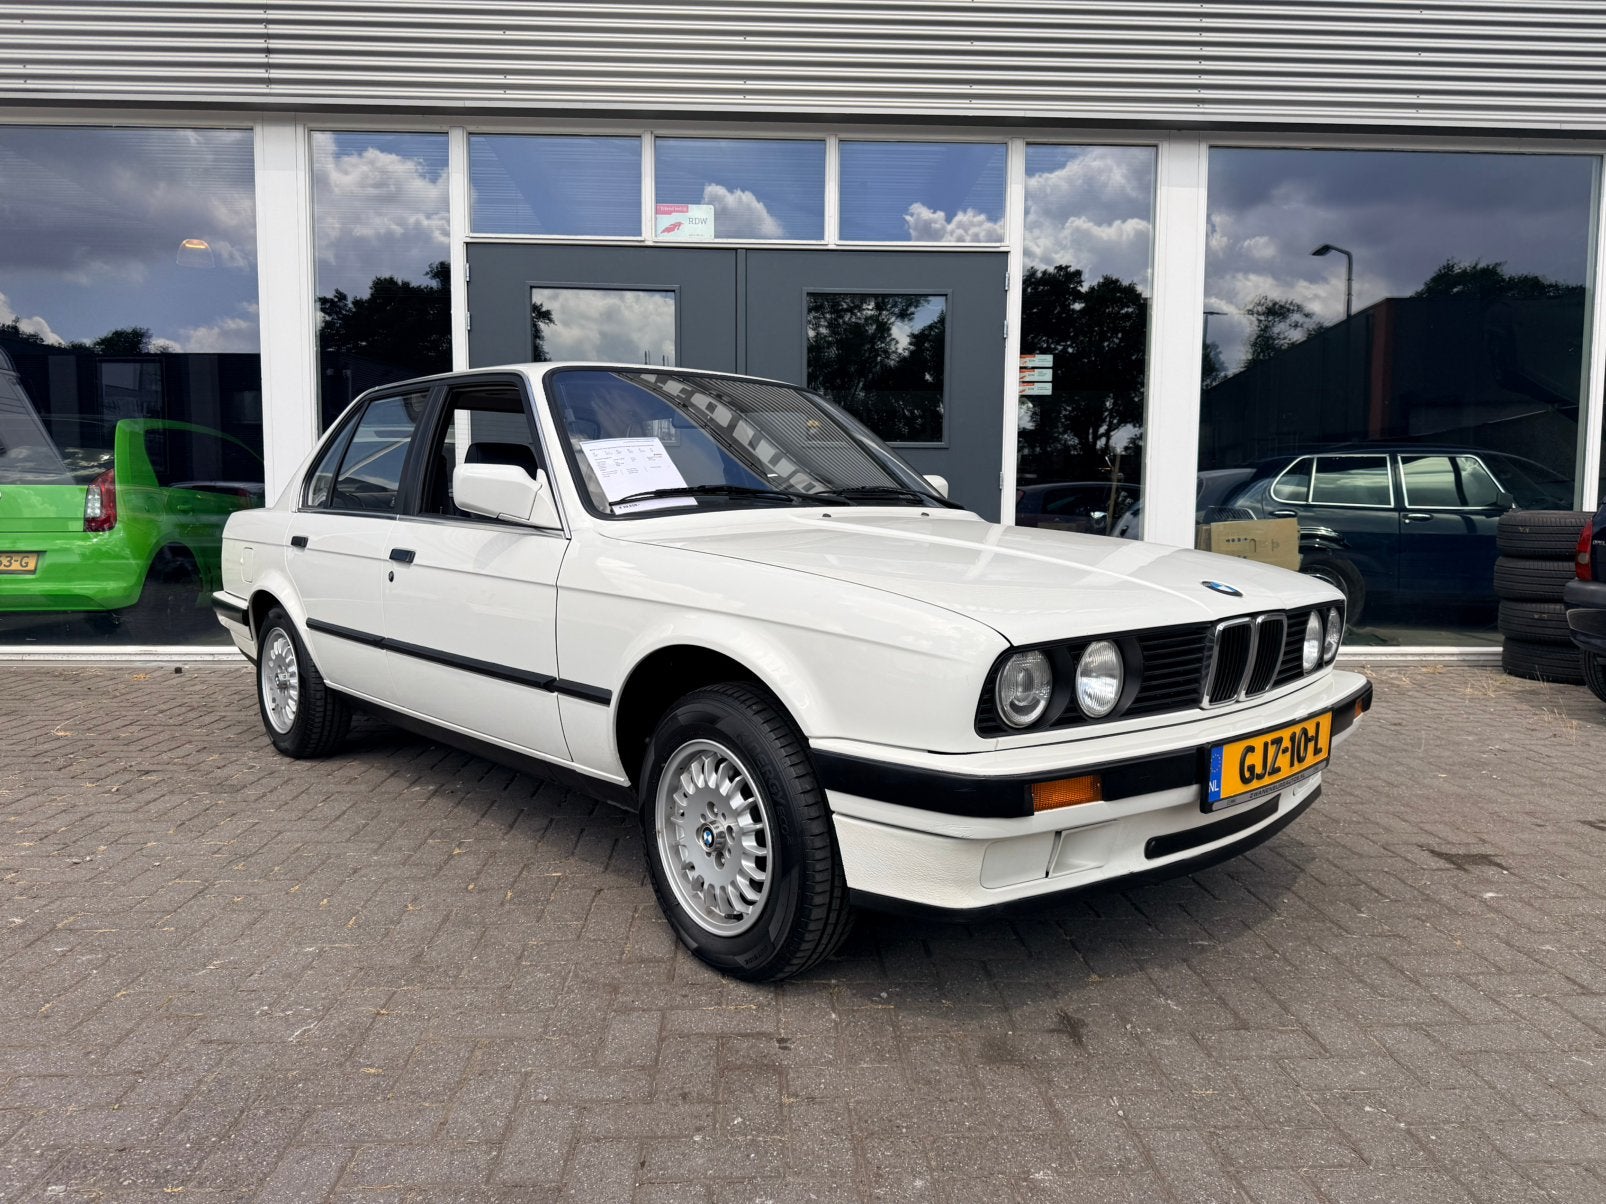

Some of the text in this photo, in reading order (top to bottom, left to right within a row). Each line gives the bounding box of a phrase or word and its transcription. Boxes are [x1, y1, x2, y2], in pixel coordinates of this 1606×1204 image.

[688, 217, 708, 225] RDW
[0, 555, 30, 568] 3-G
[1239, 721, 1323, 785] GJZ-10-L
[1208, 779, 1220, 793] NL
